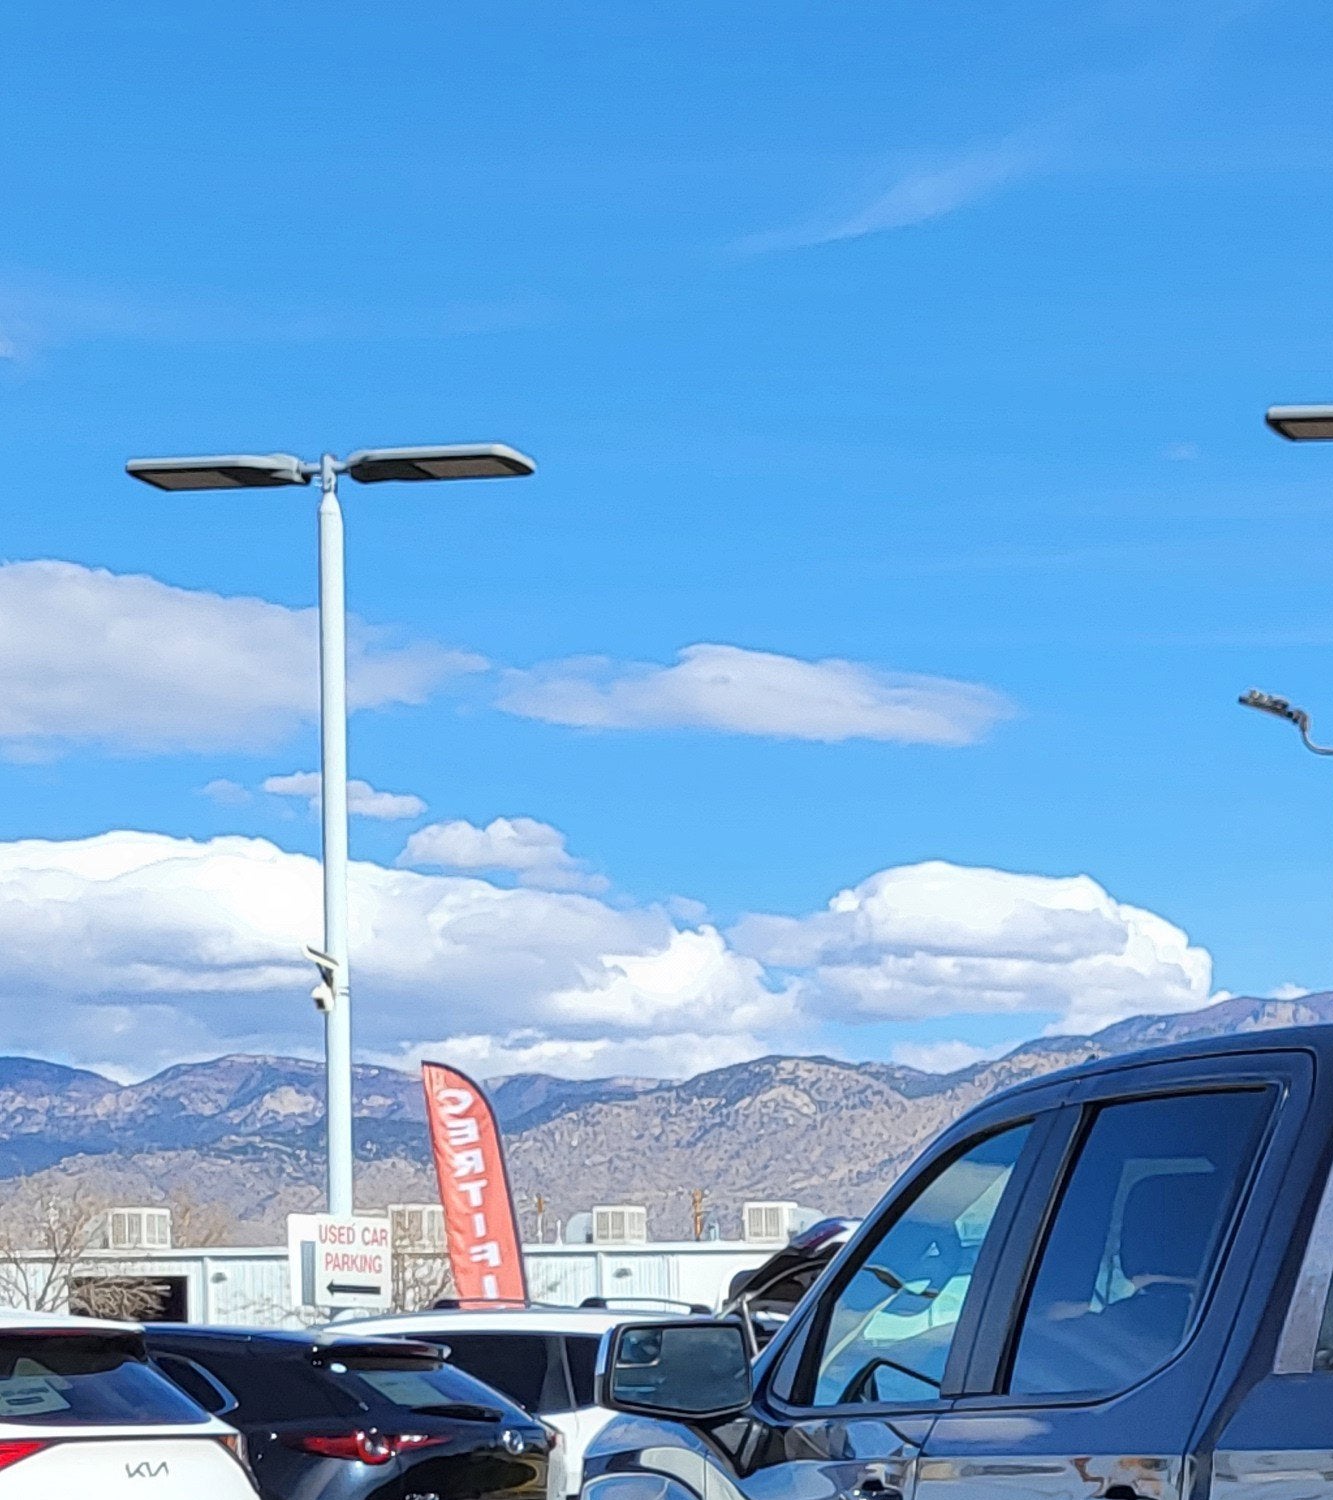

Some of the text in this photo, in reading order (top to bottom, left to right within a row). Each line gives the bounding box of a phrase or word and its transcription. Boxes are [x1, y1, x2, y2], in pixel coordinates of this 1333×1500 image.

[319, 1223, 388, 1246] USED CAR
[325, 1252, 383, 1274] PARKING
